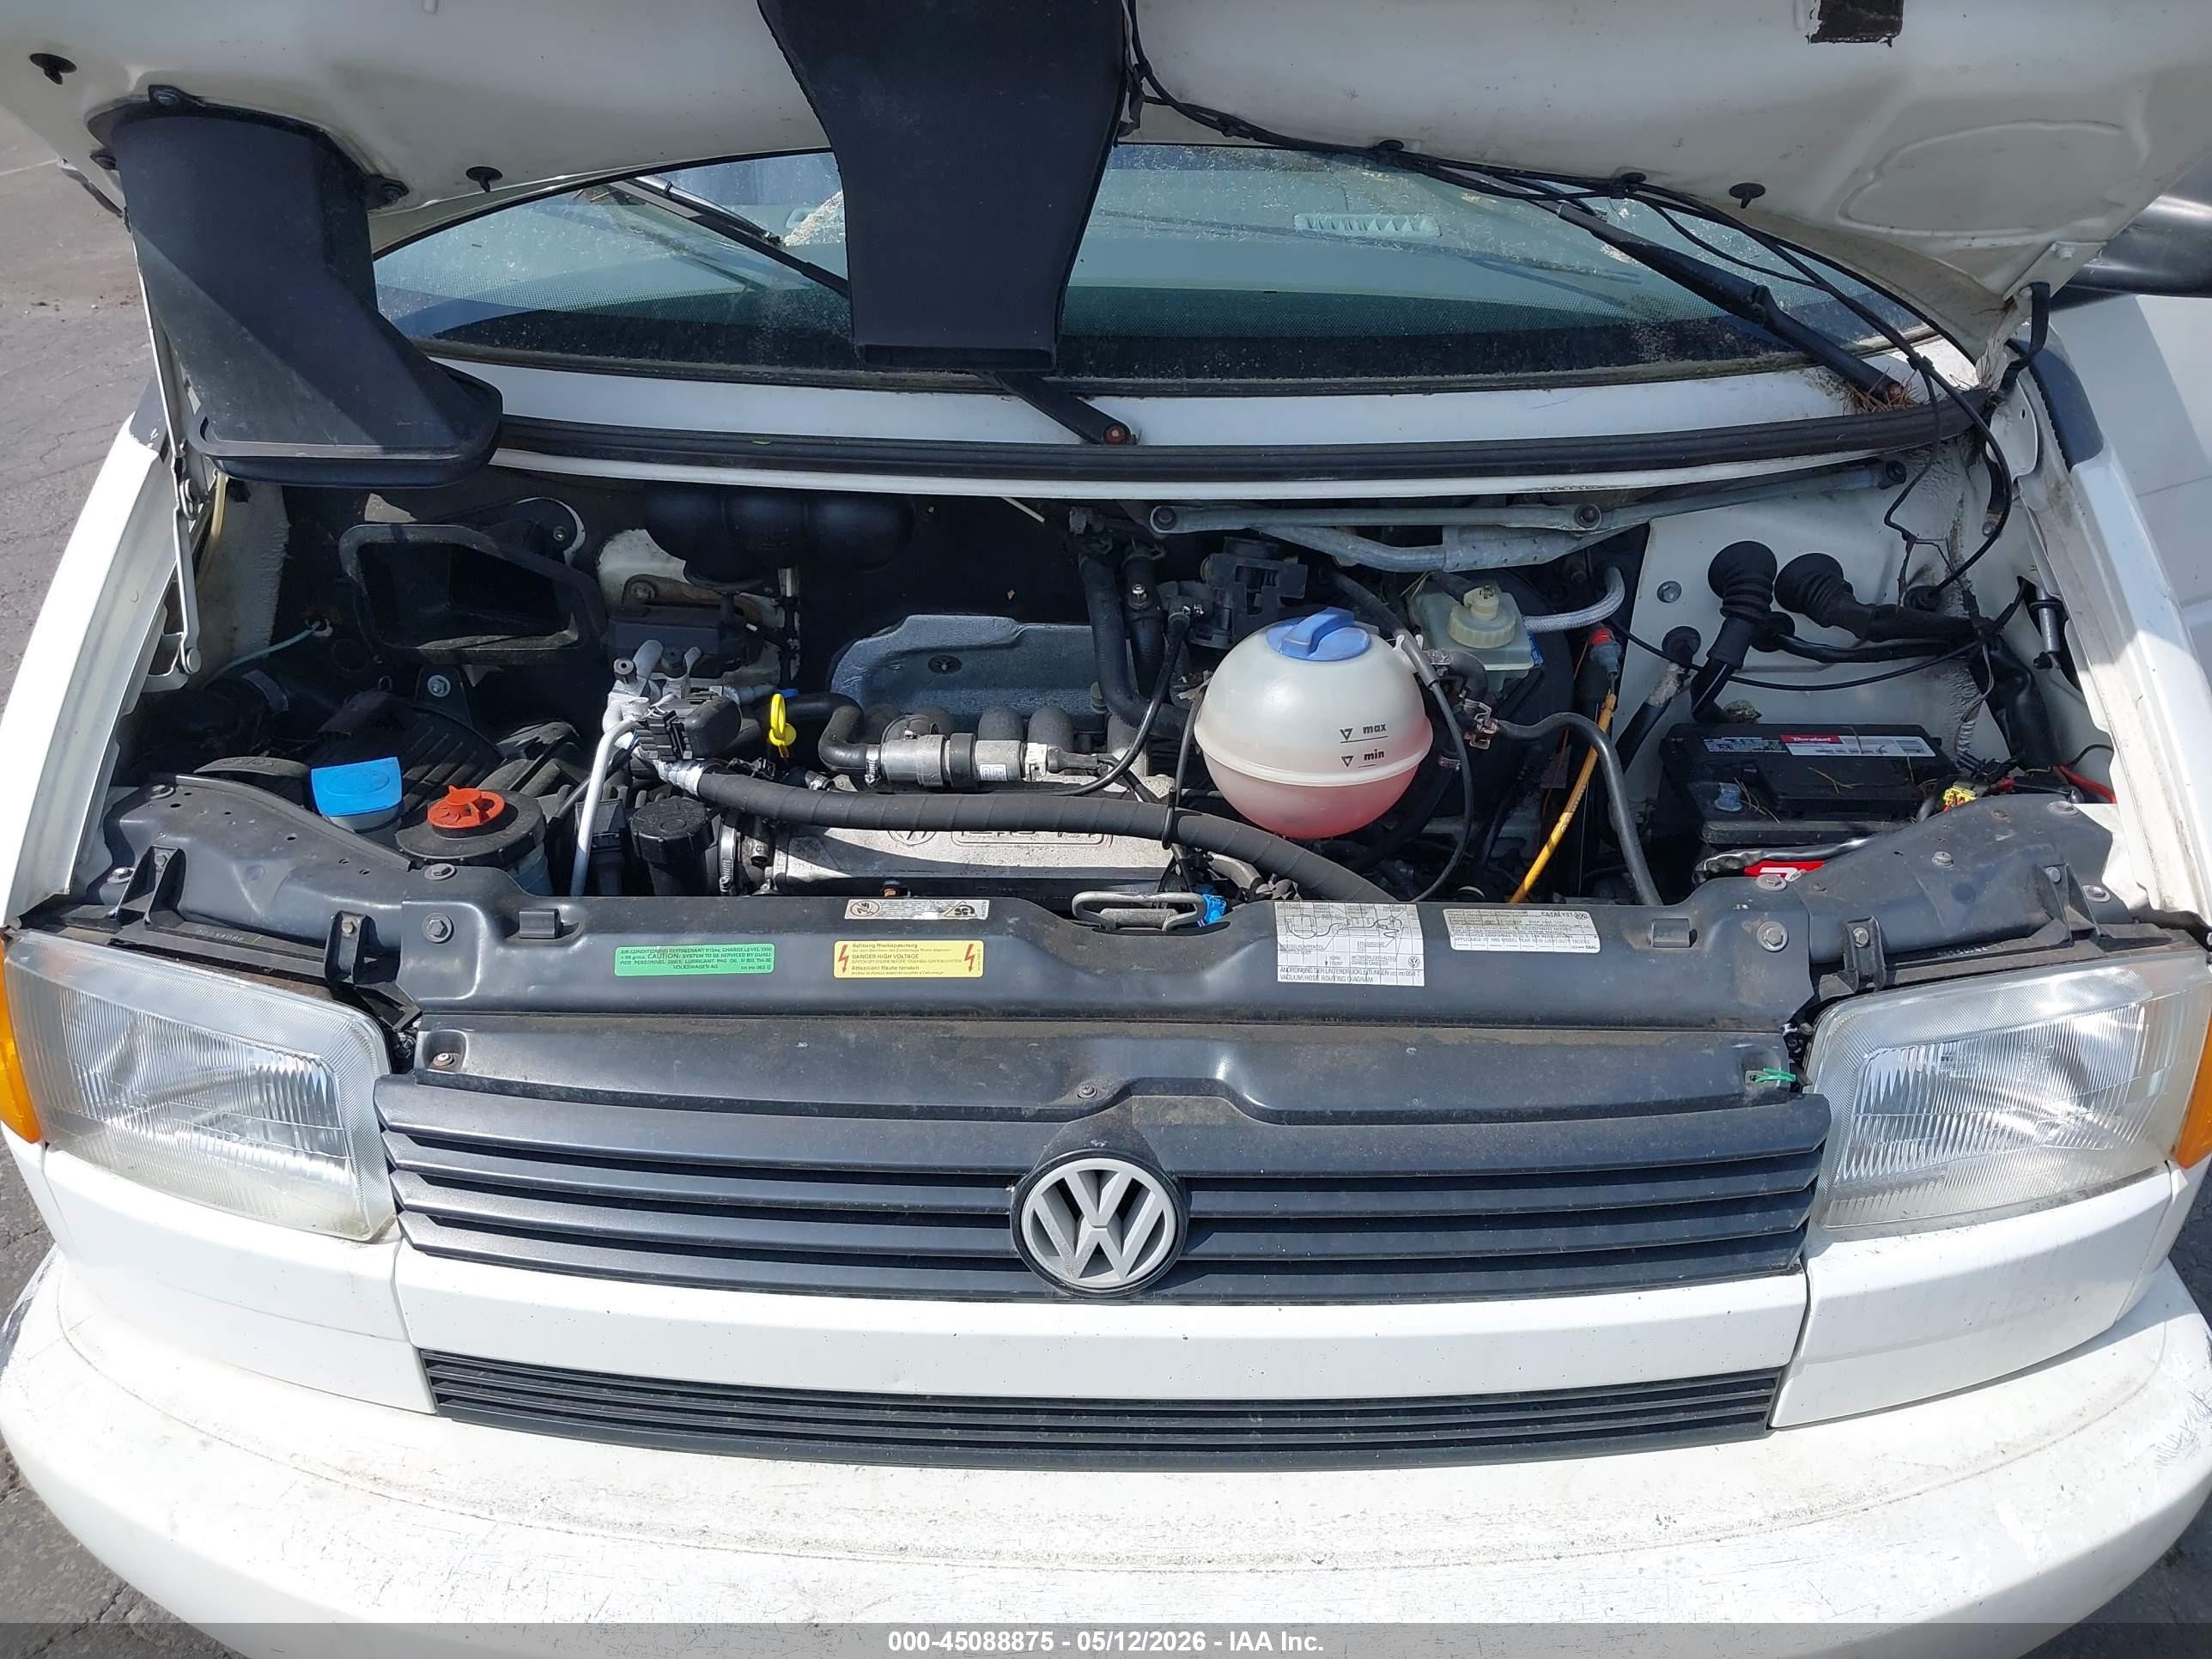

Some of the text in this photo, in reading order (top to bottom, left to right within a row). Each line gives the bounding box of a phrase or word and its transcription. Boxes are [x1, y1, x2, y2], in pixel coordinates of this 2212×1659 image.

[1363, 723, 1387, 734] max
[1364, 749, 1384, 761] min
[1021, 1158, 1176, 1290] VW
